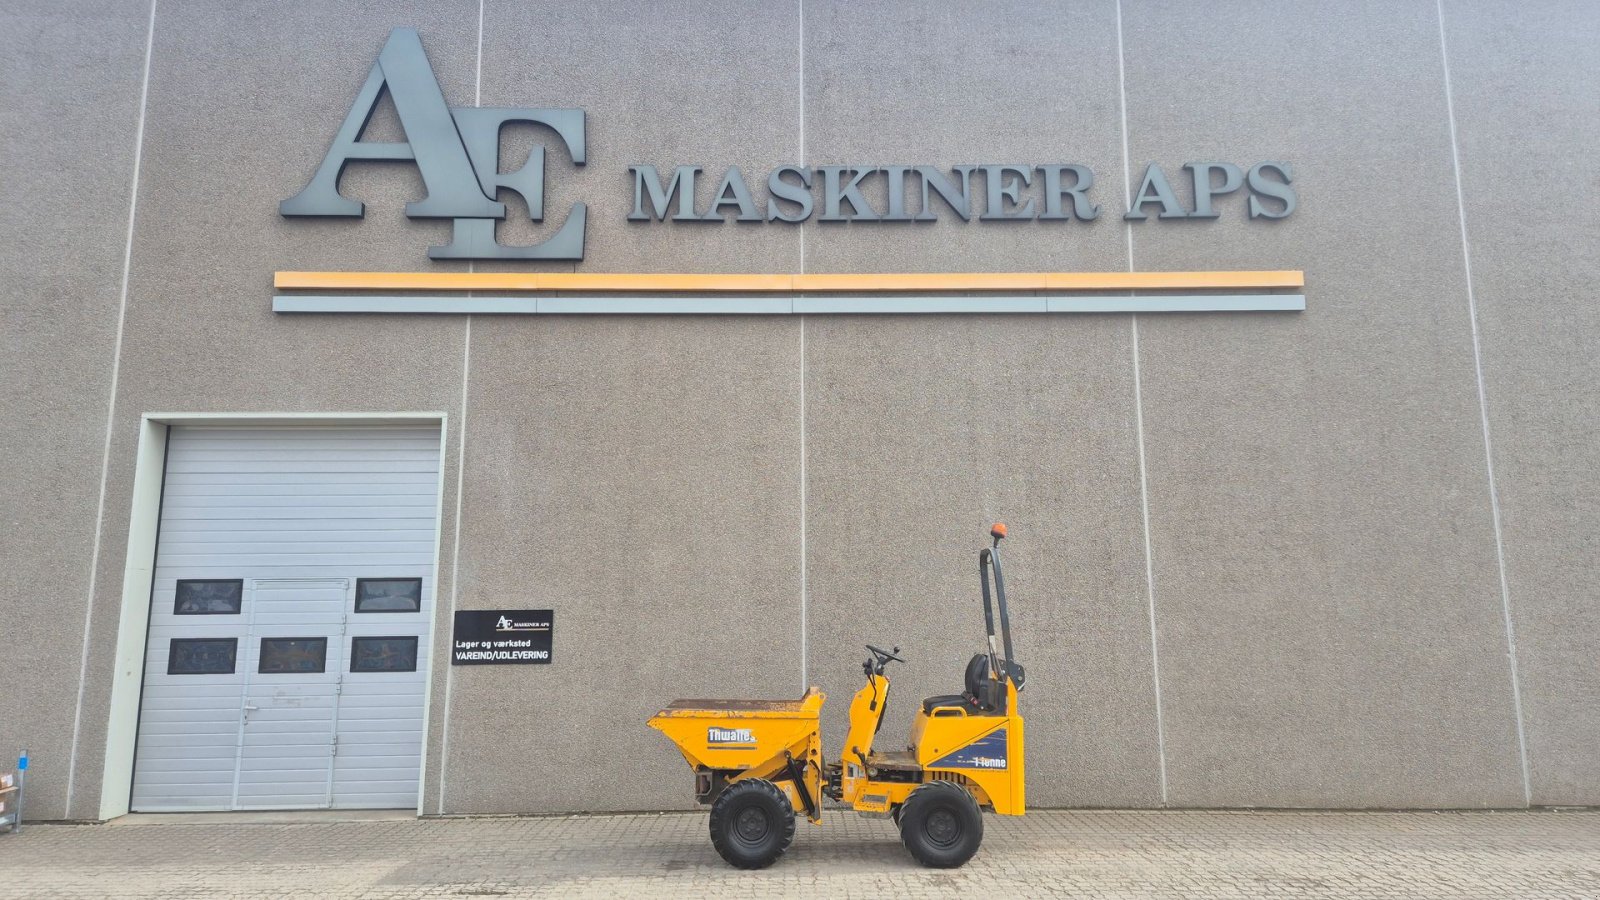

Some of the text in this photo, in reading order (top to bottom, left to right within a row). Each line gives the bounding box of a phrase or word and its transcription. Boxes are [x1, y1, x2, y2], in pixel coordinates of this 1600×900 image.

[279, 27, 1298, 261] AE MASKINER APS
[496, 615, 513, 629] AE
[456, 640, 479, 649] Lager
[494, 640, 531, 648] værksted
[456, 651, 548, 660] VAREIND/UDLEVERING
